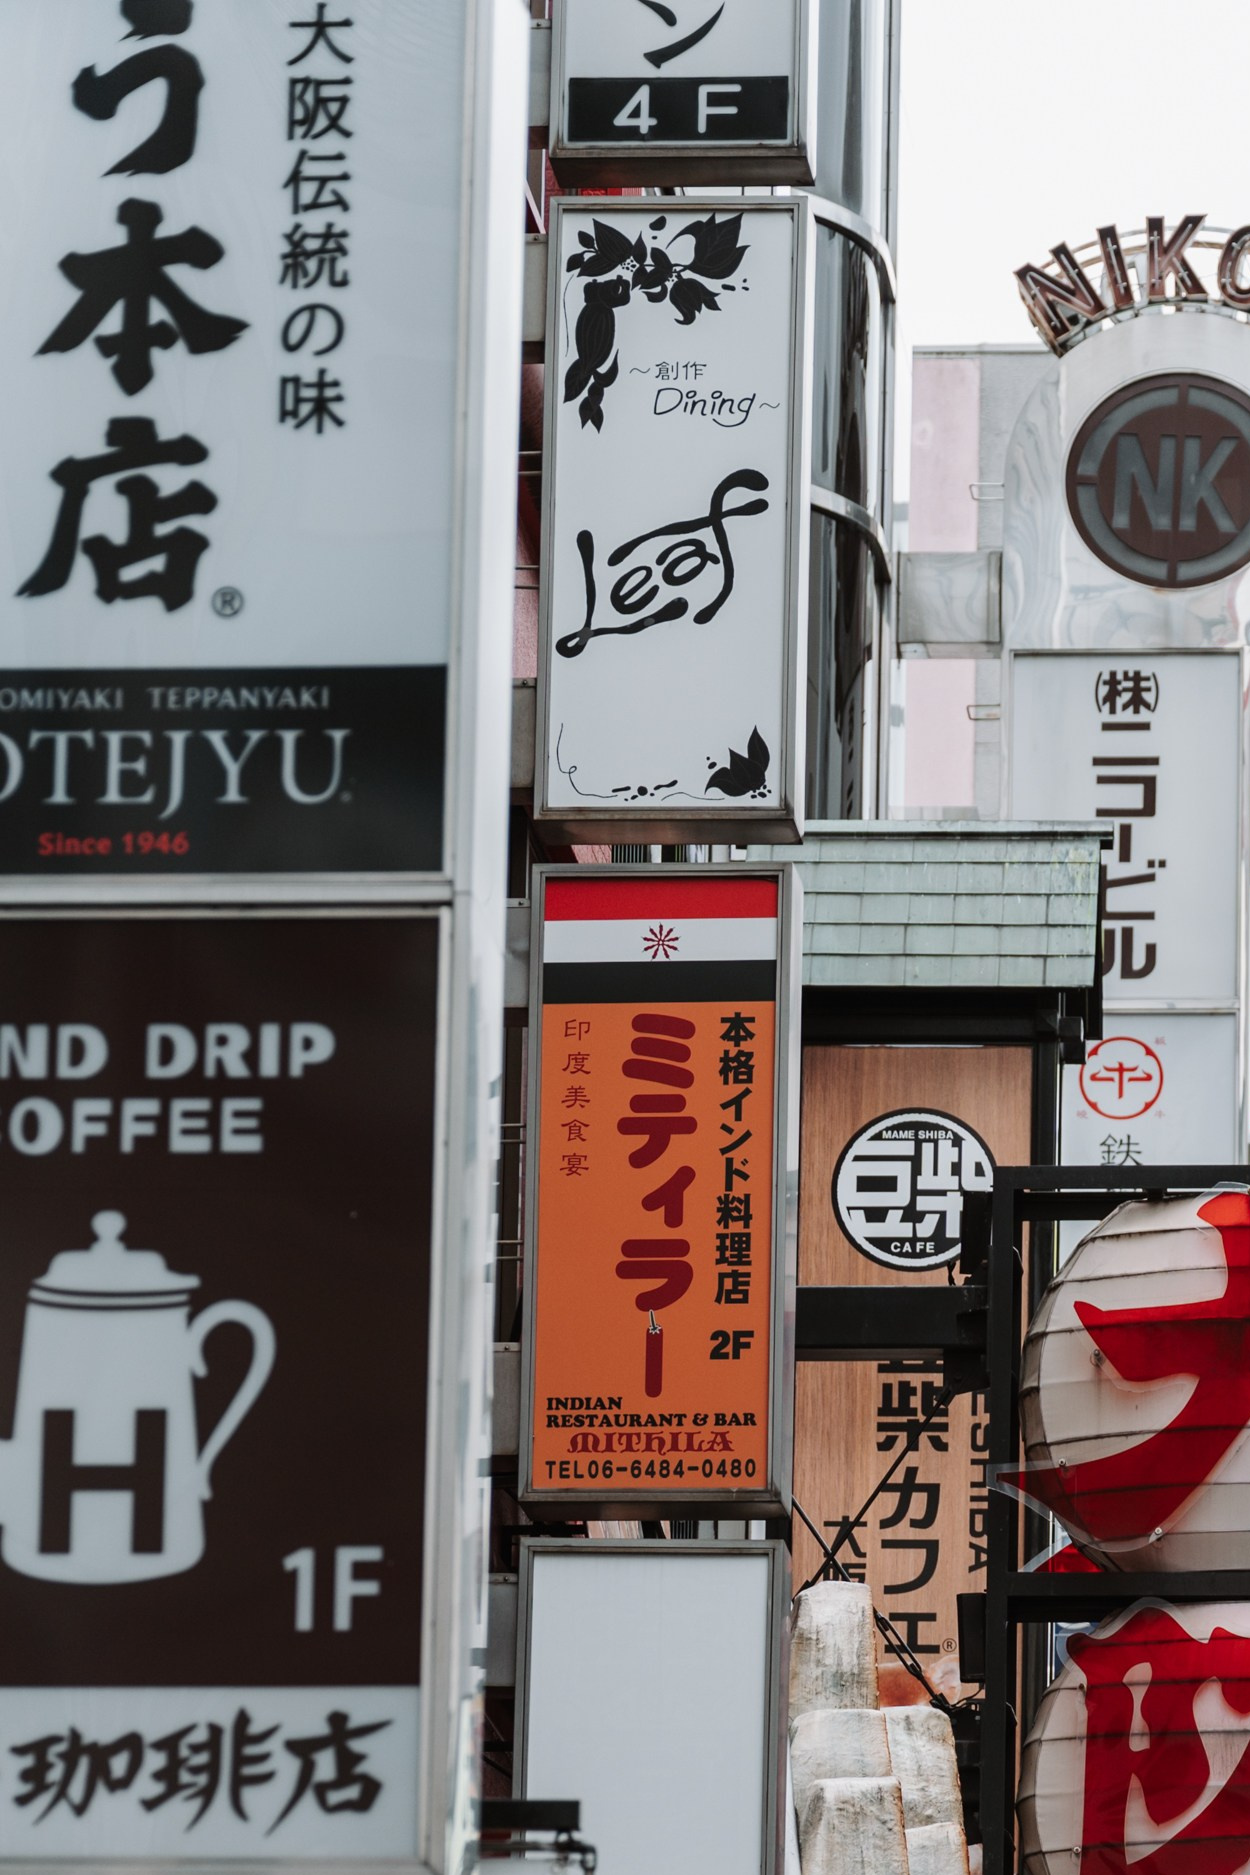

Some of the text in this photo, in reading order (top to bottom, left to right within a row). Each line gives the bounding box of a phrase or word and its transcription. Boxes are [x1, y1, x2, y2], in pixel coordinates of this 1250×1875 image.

[279, 3, 354, 435] 大阪伝統の味
[1112, 433, 1241, 533] NK
[555, 468, 770, 659] Leaf
[147, 686, 330, 709] TEPPANYAKI
[37, 830, 190, 856] Since 1946
[144, 1022, 337, 1080] DRIP
[558, 1016, 592, 1178] 印度美食宴
[713, 1011, 757, 1306] 本格インド料理店
[881, 1130, 954, 1140] MAME SHIBA
[614, 1013, 699, 1398] ミティラー
[890, 1241, 936, 1254] CAFE
[708, 1329, 756, 1362] 2F
[545, 1412, 758, 1428] RESTAURANT & BAR
[546, 1396, 623, 1411] INDIAN
[281, 1546, 383, 1632] 1F
[9, 1706, 395, 1838] 珈琲店
